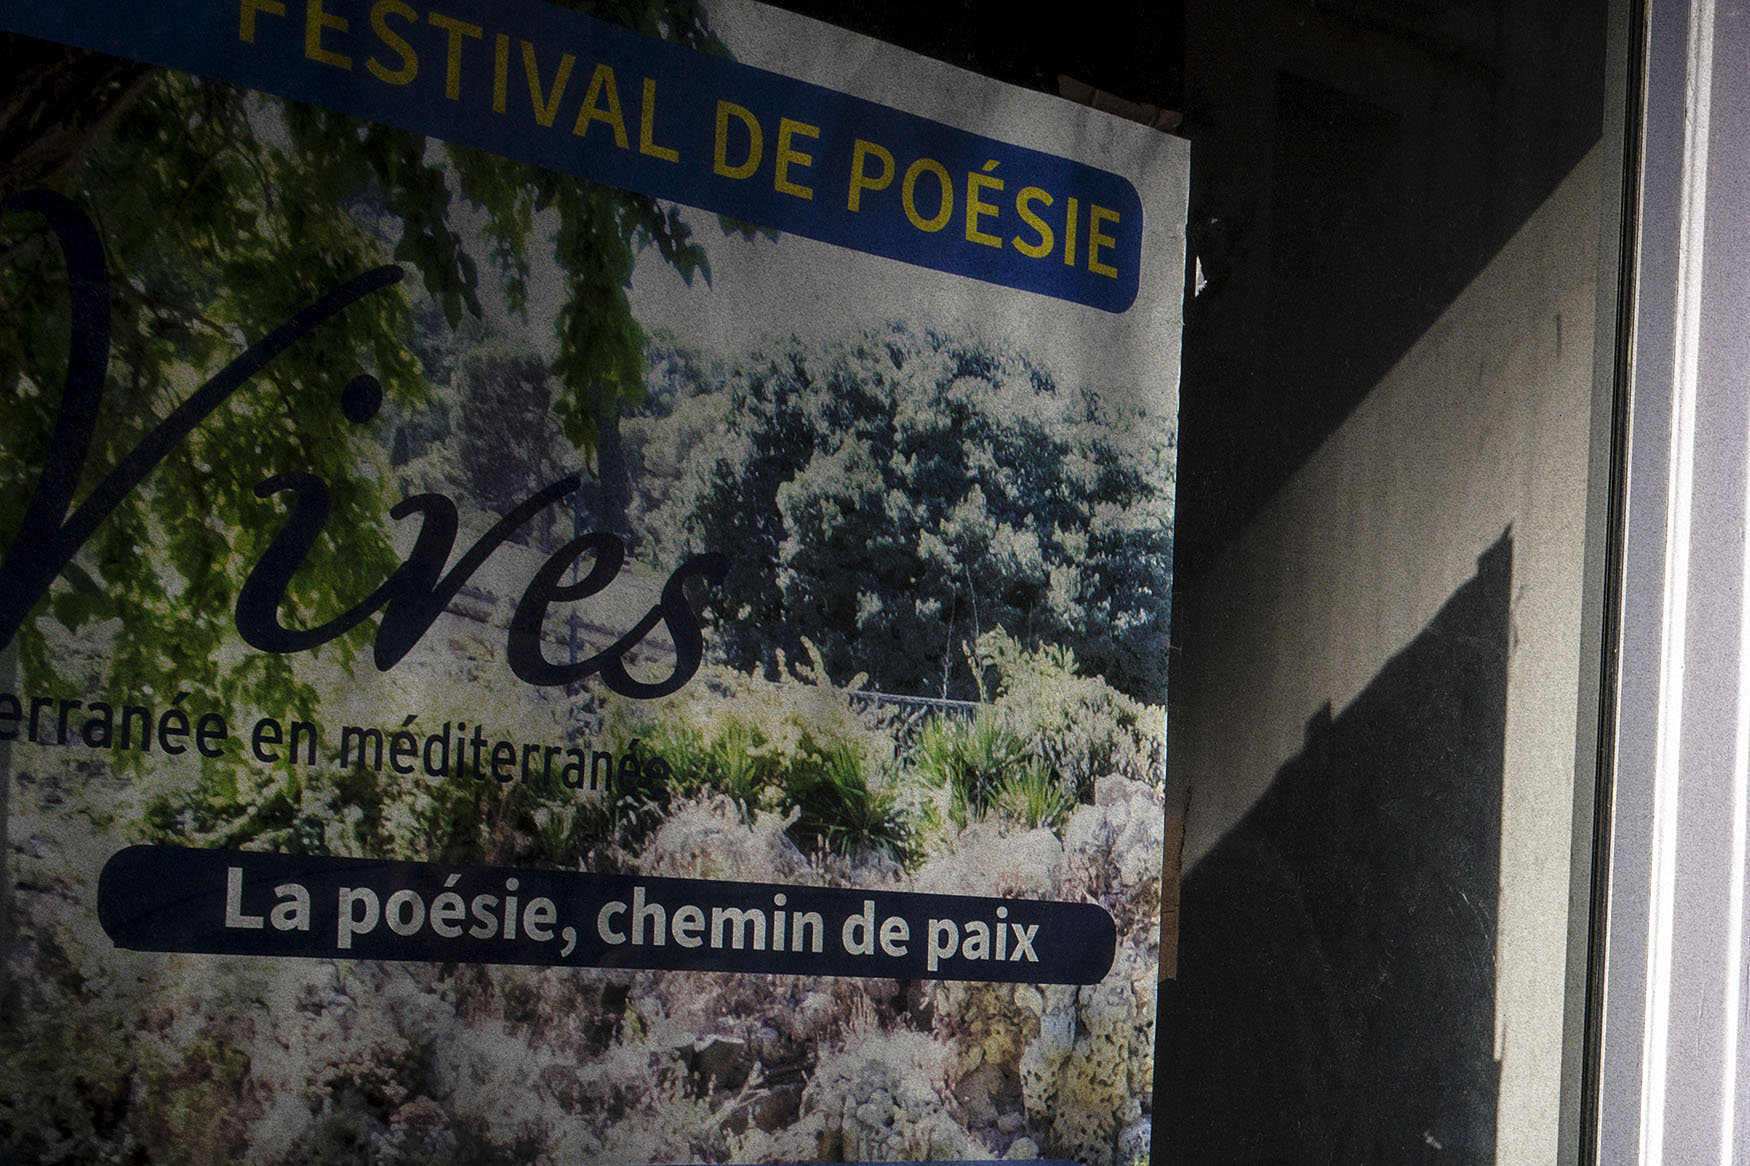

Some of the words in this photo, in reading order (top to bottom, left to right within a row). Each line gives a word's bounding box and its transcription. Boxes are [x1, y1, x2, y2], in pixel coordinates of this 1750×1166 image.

[238, 0, 680, 164] FESTIVAL
[712, 99, 820, 200] DE
[846, 138, 1121, 281] POÉSIE
[251, 717, 318, 766] en
[340, 715, 672, 801] méditerranée
[224, 865, 311, 932] La
[336, 872, 577, 959] poésie,
[596, 885, 825, 955] chemin
[840, 900, 910, 959] de
[926, 906, 1041, 972] paix
